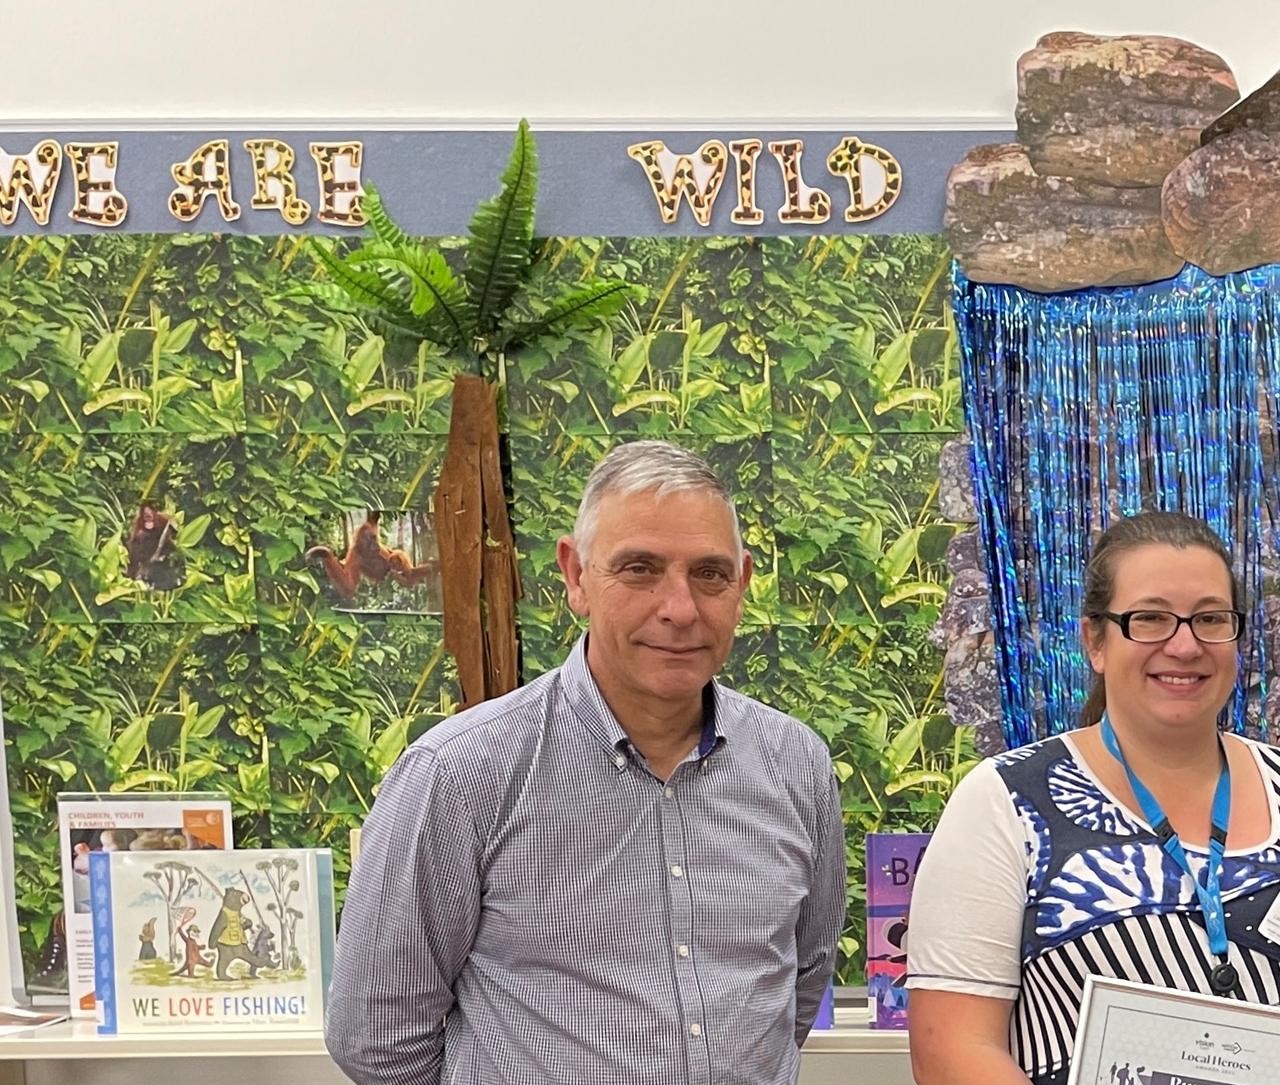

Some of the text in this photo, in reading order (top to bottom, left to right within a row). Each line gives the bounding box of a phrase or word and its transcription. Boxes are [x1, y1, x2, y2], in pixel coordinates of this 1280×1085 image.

[0, 138, 128, 226] WE
[168, 138, 369, 226] ARE
[626, 136, 905, 226] WILD
[132, 995, 307, 1017] WE LOVE FISHING!
[1181, 1050, 1252, 1071] Local Heroes
